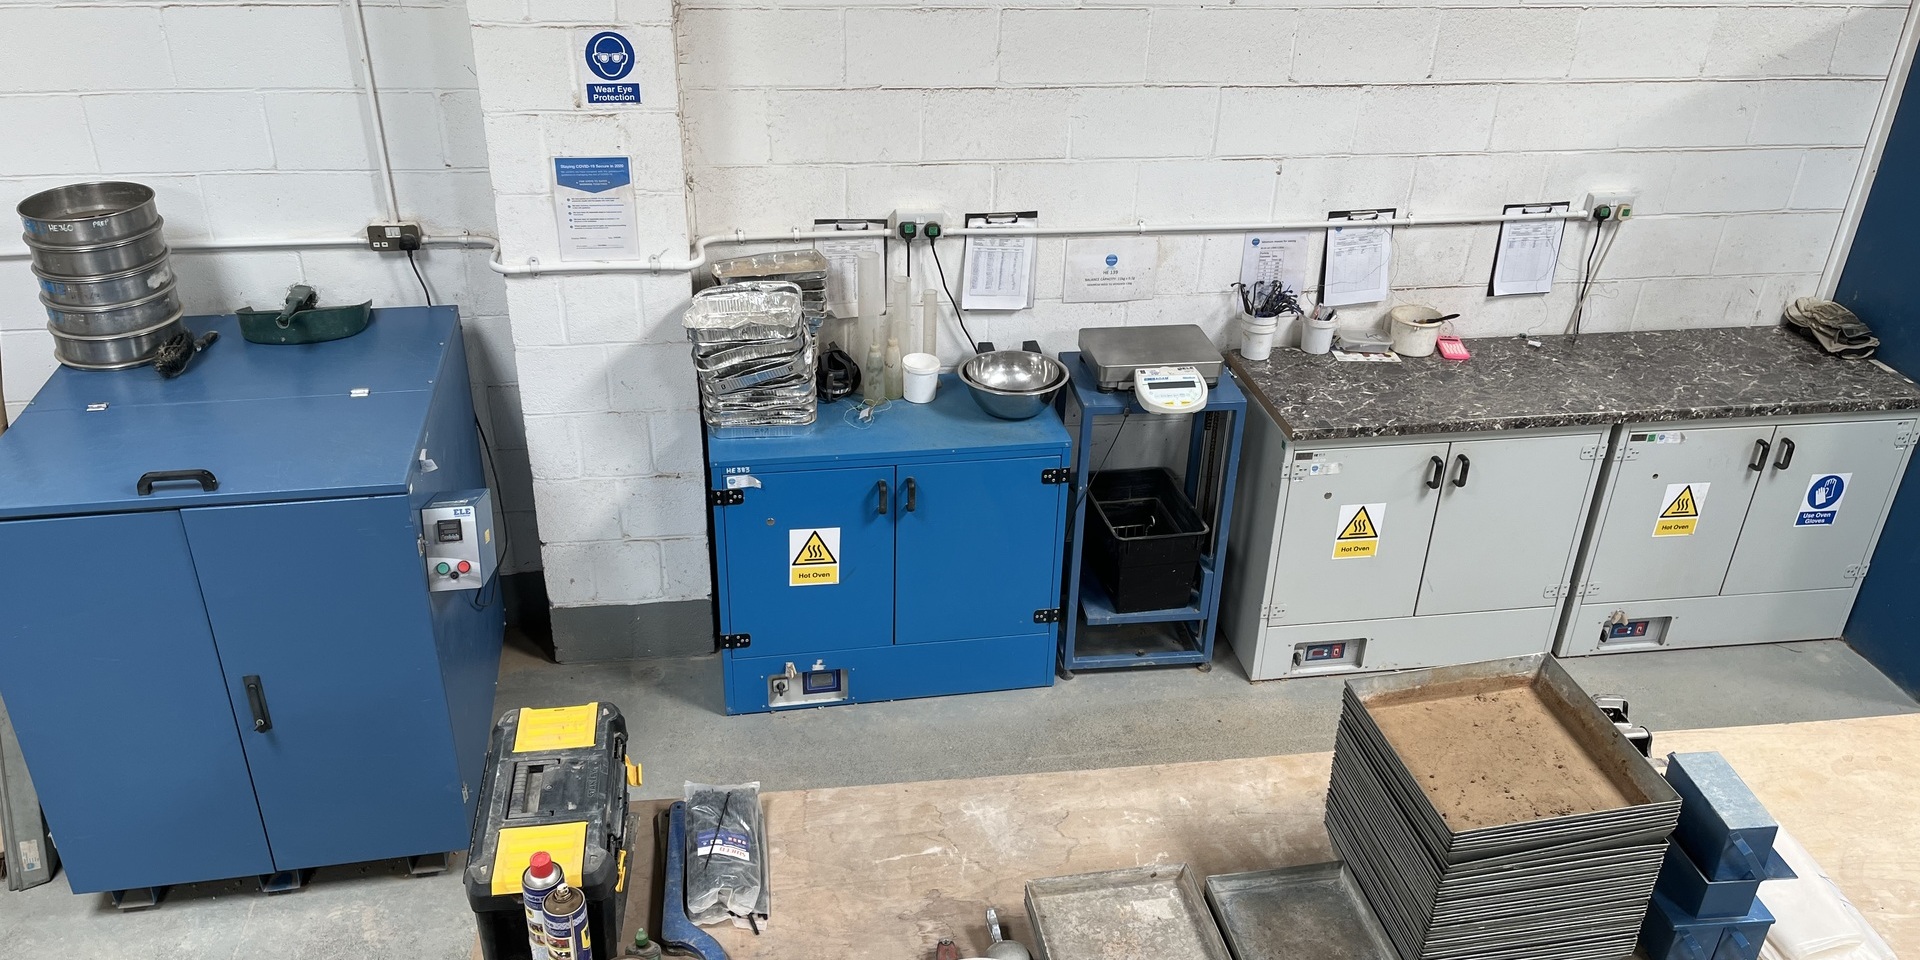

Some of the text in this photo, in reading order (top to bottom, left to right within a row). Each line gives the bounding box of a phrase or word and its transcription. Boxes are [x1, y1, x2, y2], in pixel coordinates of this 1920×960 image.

[617, 85, 633, 94] Eye
[92, 219, 109, 228] PREP
[453, 508, 471, 516] ELE
